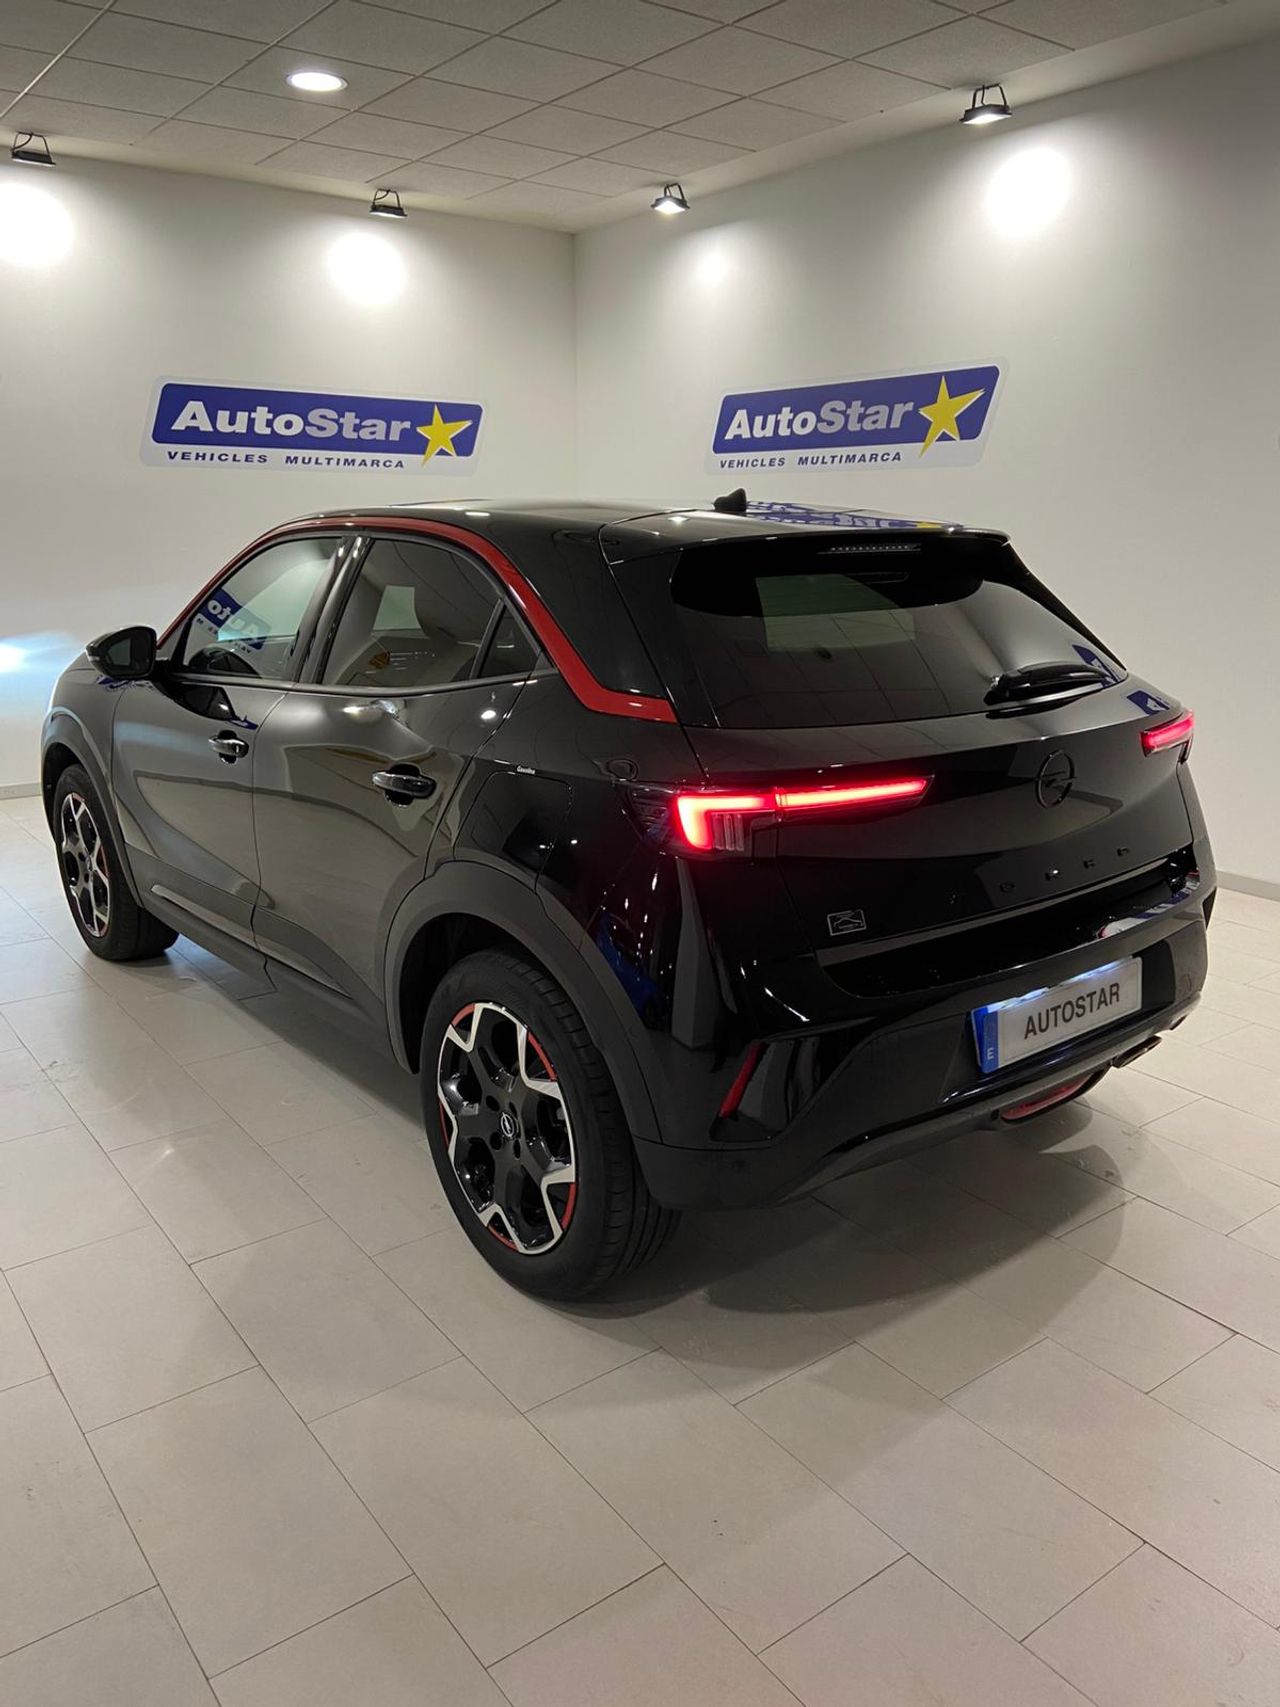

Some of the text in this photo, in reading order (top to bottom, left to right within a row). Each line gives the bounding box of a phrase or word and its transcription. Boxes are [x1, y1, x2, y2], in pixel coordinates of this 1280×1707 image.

[171, 400, 411, 441] AutoStar
[724, 400, 913, 440] AutoStar
[167, 451, 405, 469] VEHICLES MULTIMARCA
[719, 451, 902, 469] VEHICLES MULTIMARCA
[1024, 983, 1120, 1039] AUTOSTAR
[986, 1047, 995, 1061] E
